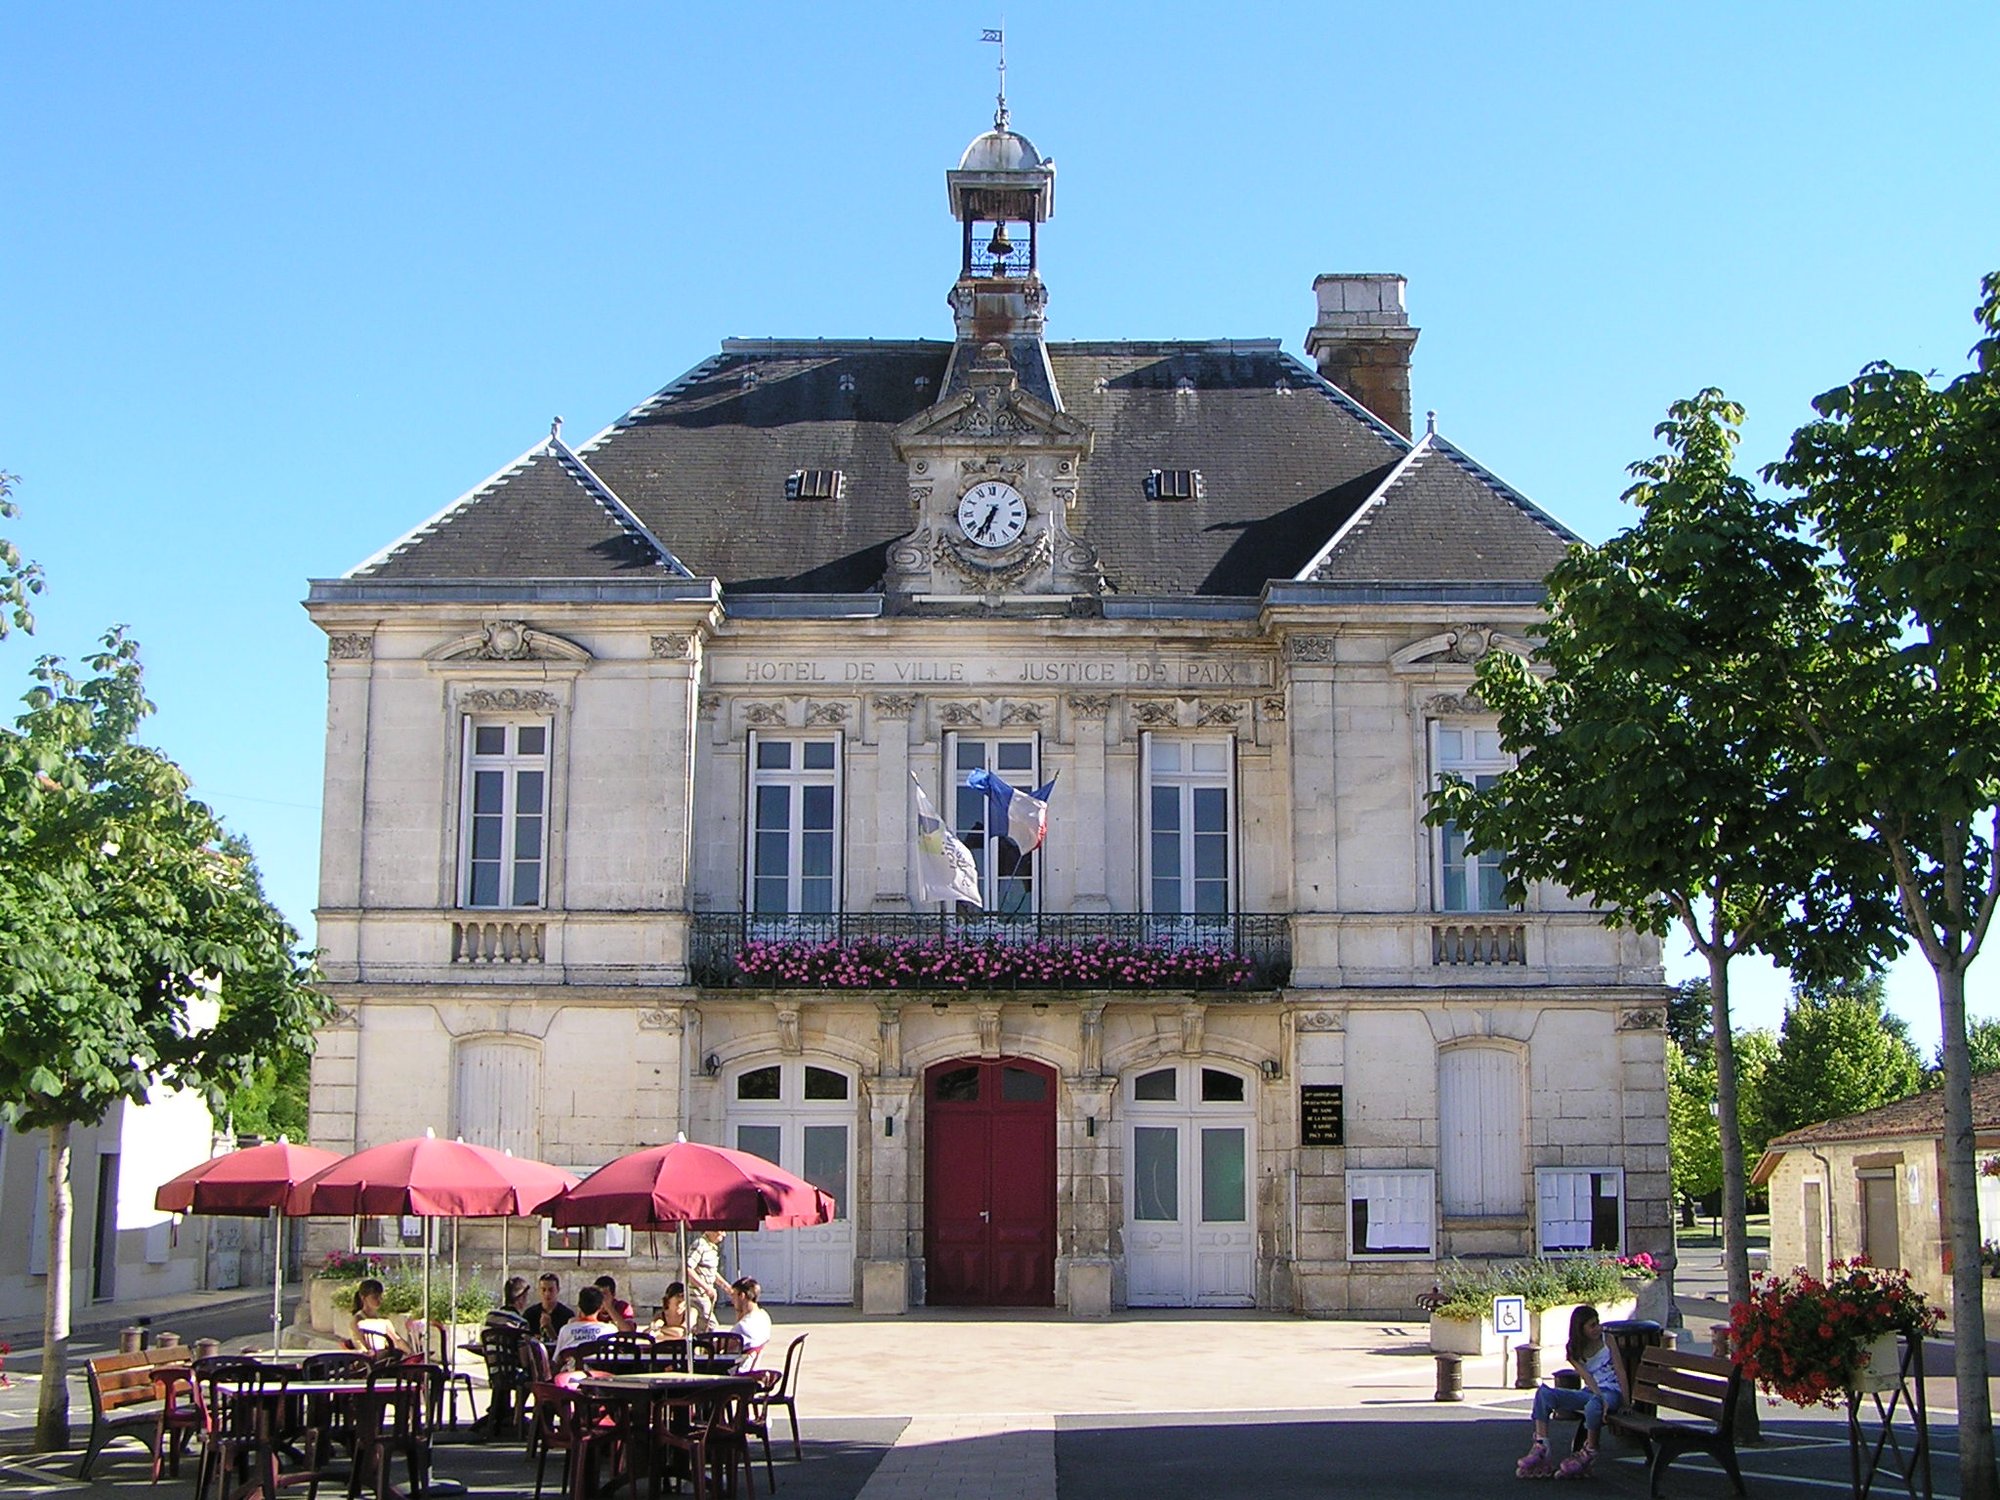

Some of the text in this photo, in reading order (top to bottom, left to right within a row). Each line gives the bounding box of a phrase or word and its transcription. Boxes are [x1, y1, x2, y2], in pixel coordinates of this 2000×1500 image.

[745, 662, 1236, 682] HOTEL DE VILLE JUSTICE DE PAIX
